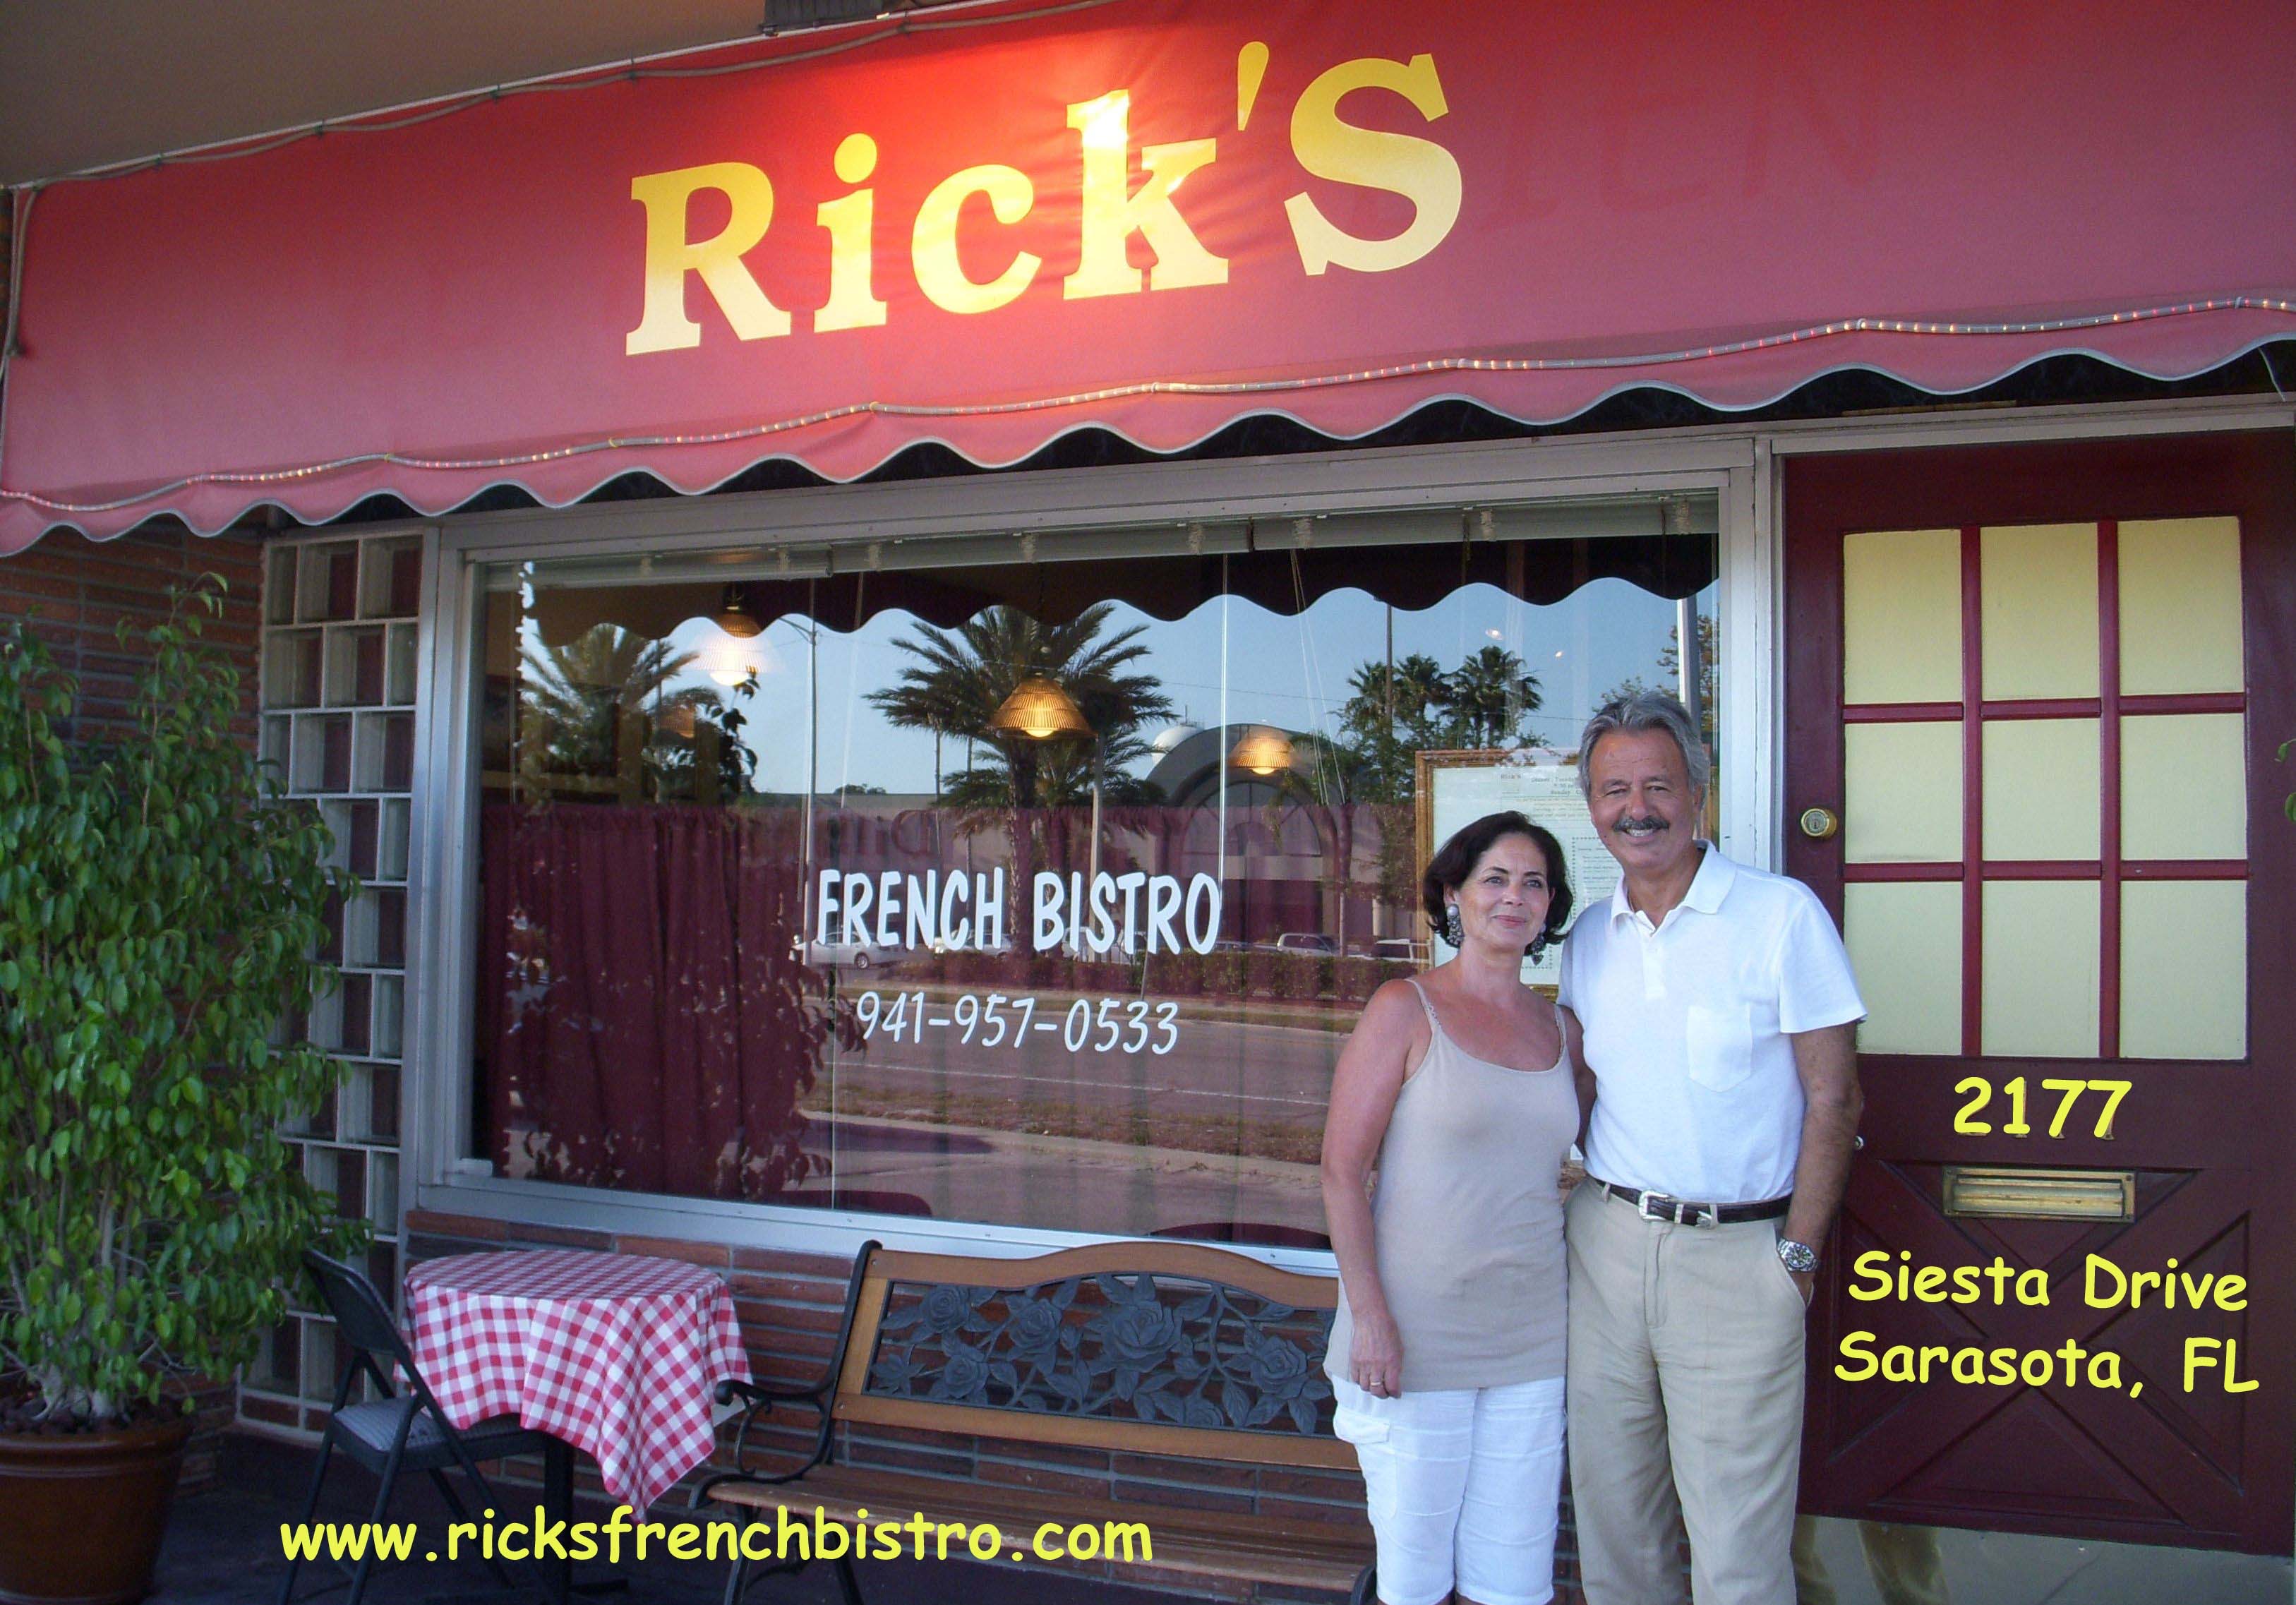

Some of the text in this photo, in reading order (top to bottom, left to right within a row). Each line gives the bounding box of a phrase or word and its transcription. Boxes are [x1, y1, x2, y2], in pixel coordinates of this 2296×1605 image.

[817, 866, 1221, 955] FRENCH BISTRO
[856, 990, 1179, 1054] 941-957-0533
